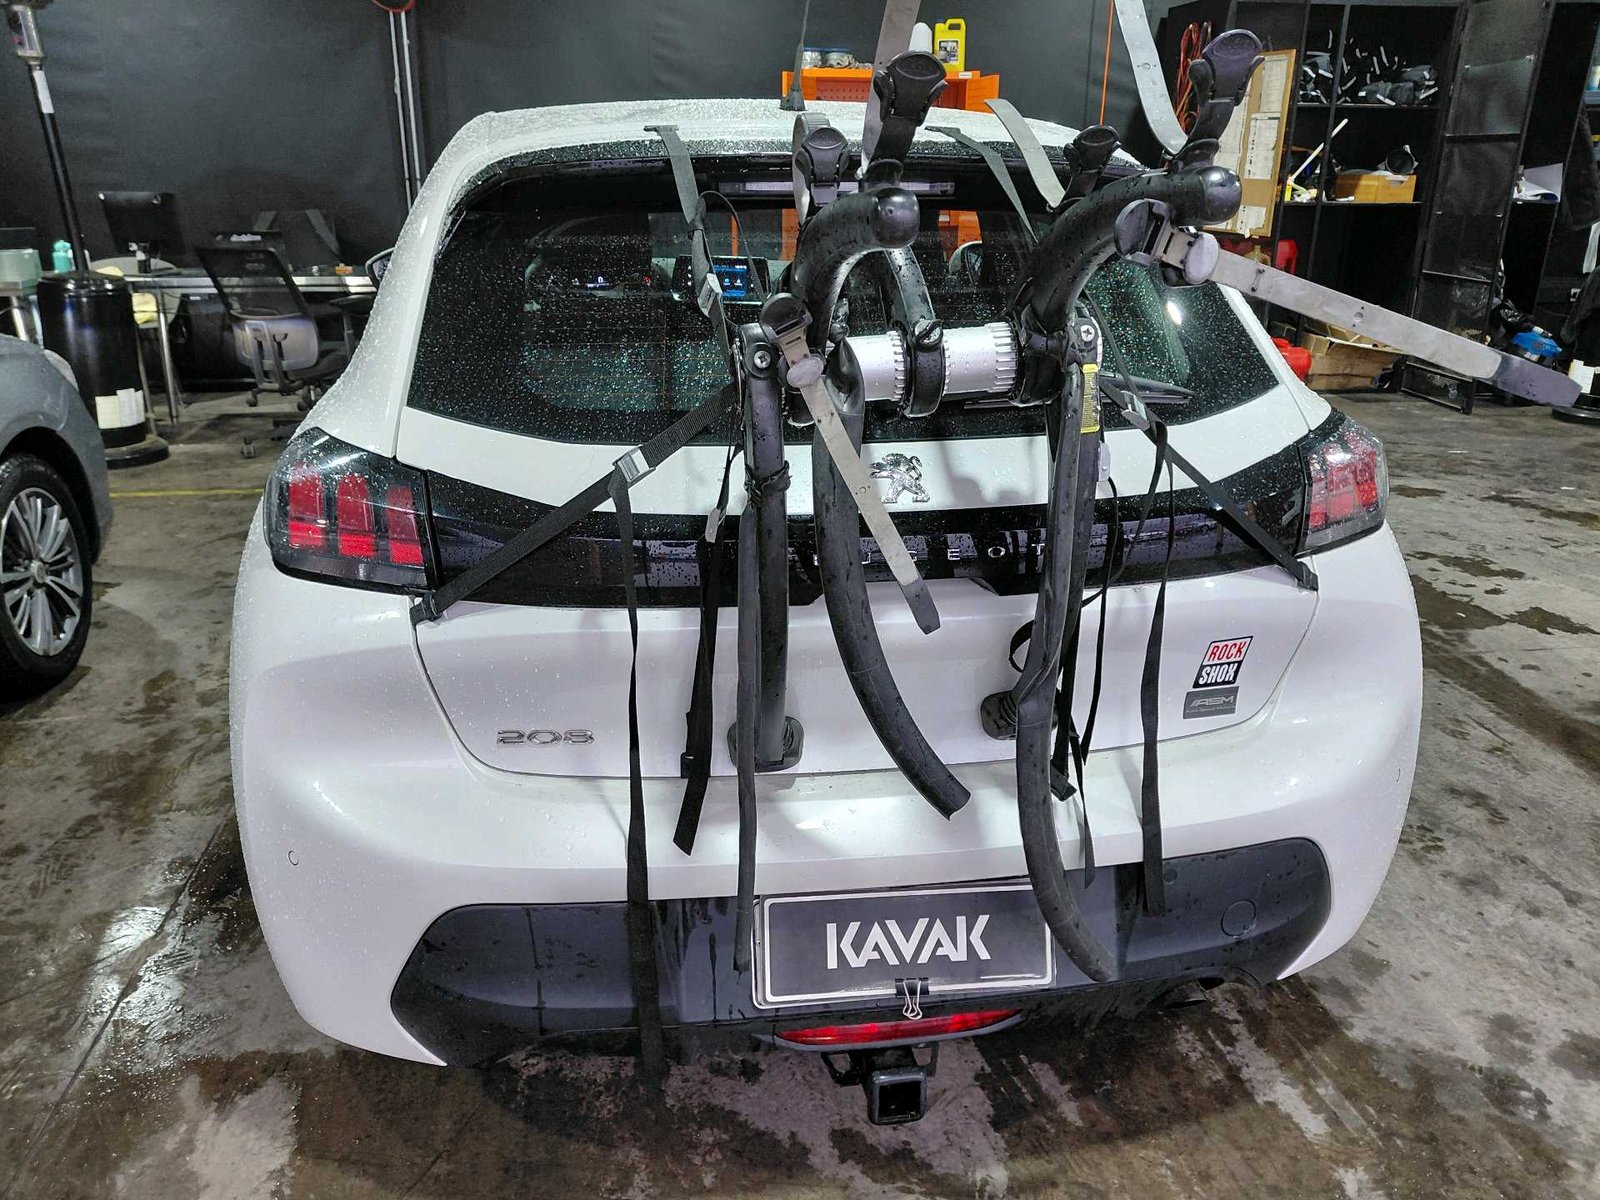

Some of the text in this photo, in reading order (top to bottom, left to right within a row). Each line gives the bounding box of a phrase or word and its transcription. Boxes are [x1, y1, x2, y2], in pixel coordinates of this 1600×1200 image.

[1208, 641, 1247, 661] ROCK
[1198, 663, 1239, 685] SHOX
[496, 729, 595, 745] 208
[826, 914, 992, 970] KAVAK
